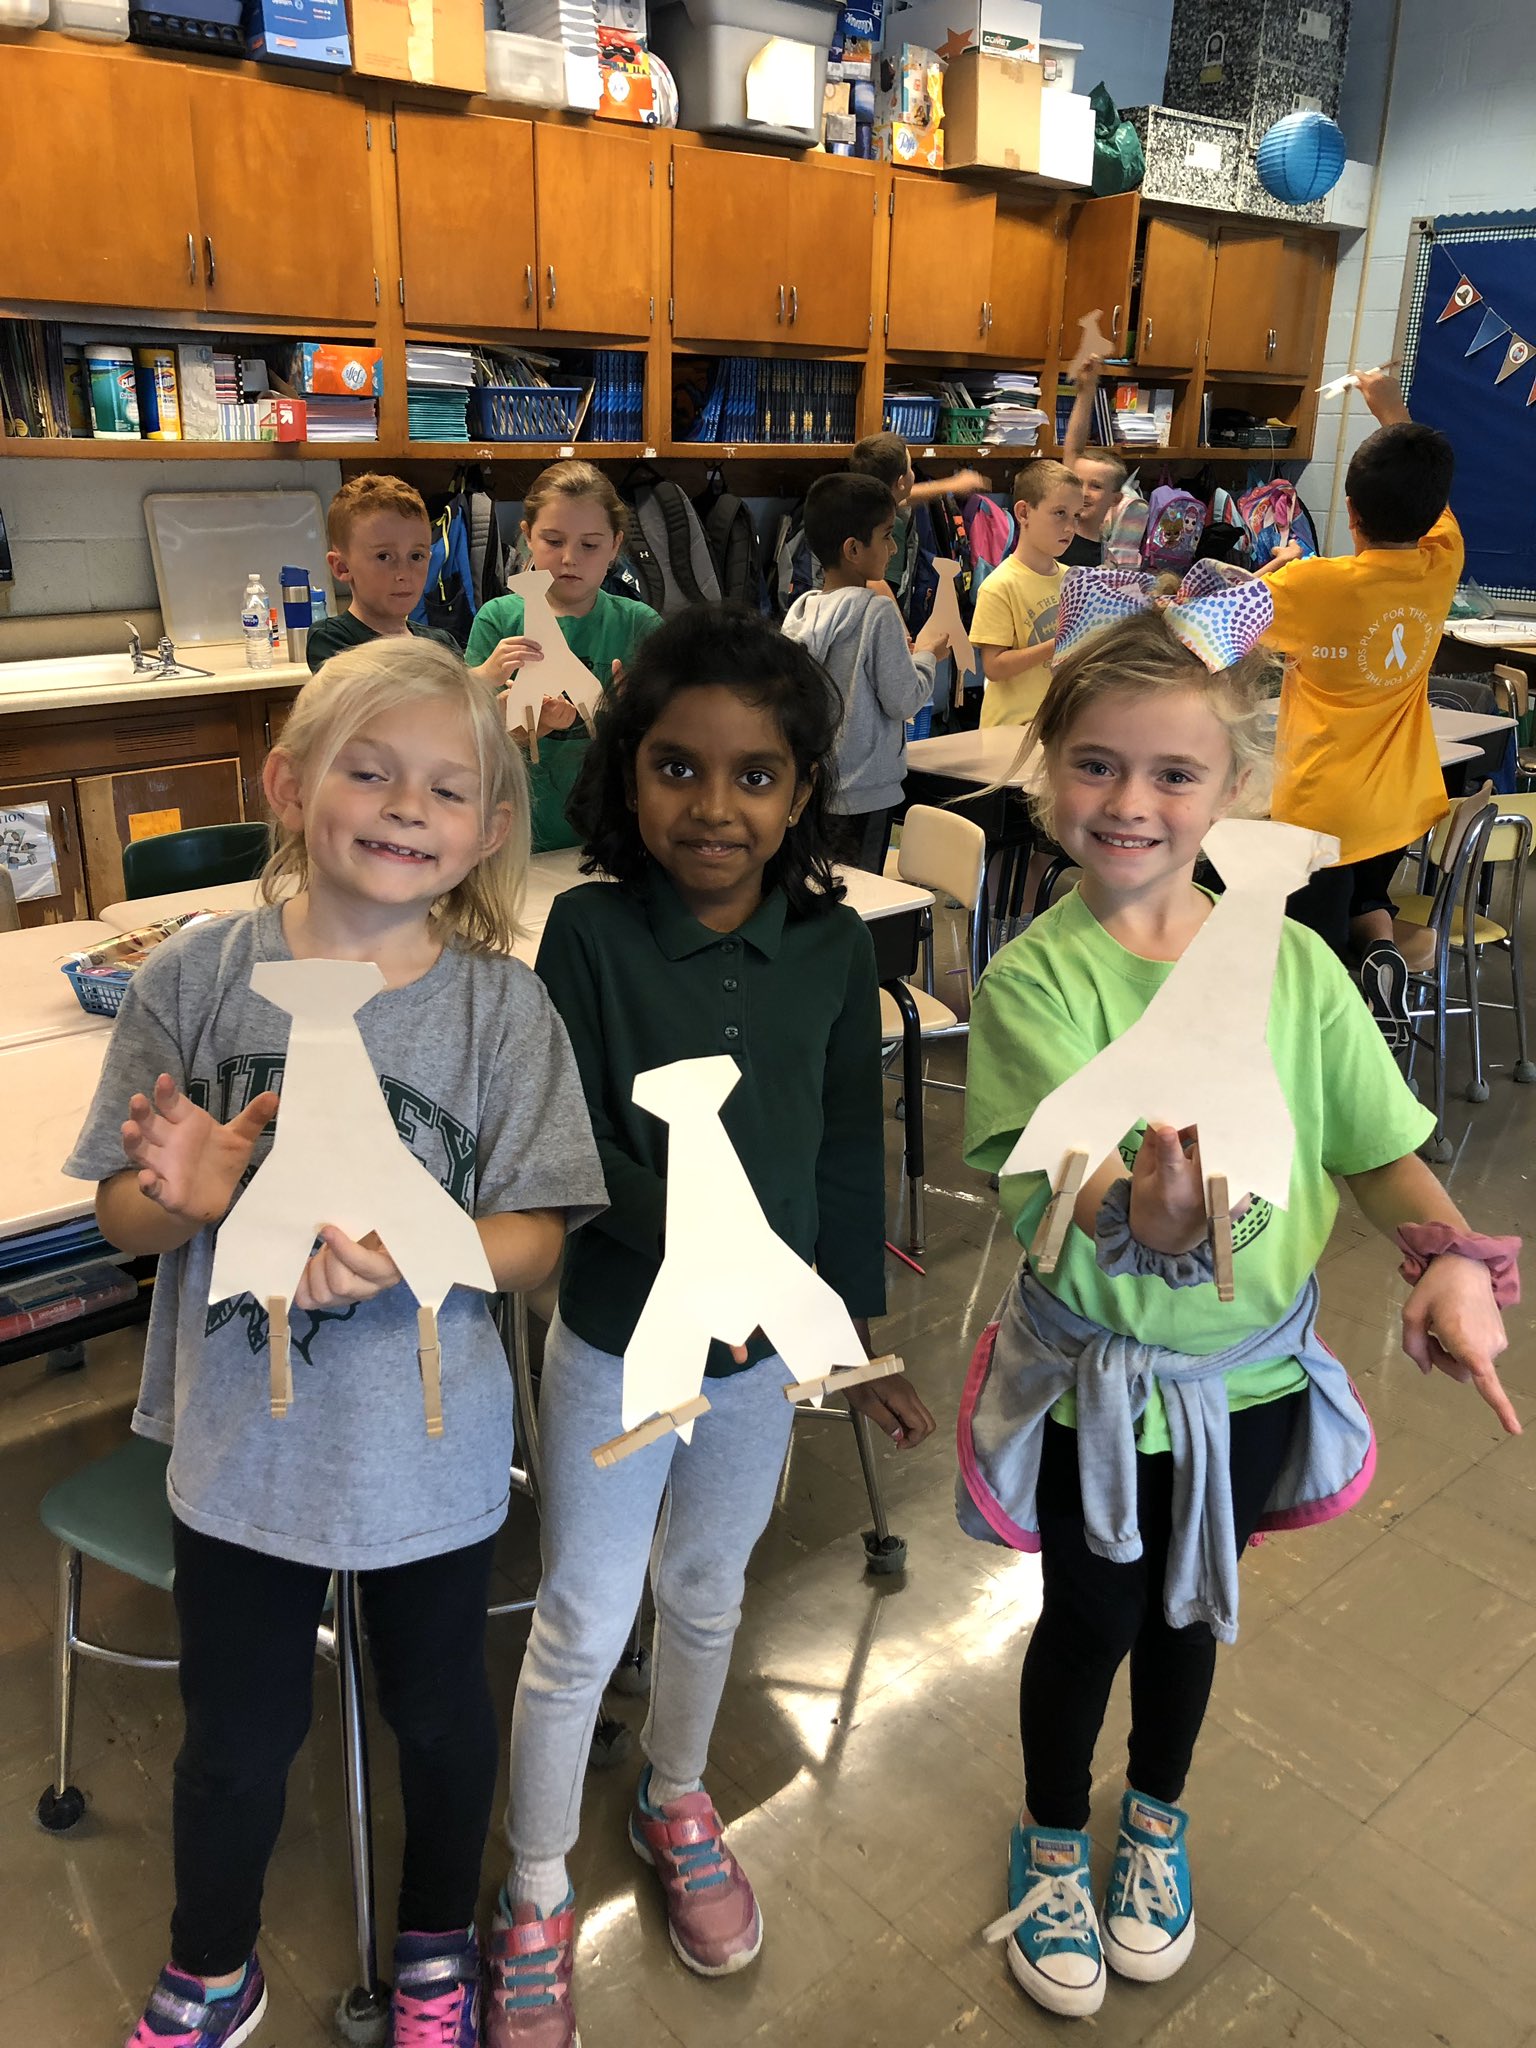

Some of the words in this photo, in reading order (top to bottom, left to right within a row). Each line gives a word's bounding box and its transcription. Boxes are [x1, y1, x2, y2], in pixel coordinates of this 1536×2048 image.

[984, 35, 1011, 47] COMET
[898, 132, 916, 153] Puffs
[345, 366, 363, 384] Puffs
[1037, 595, 1058, 609] THE
[1360, 619, 1380, 646] PLAY
[1382, 607, 1405, 622] FOR
[1408, 607, 1428, 623] THE
[1312, 645, 1348, 659] 2019
[1357, 648, 1368, 673] KIDS
[1365, 671, 1383, 686] THE
